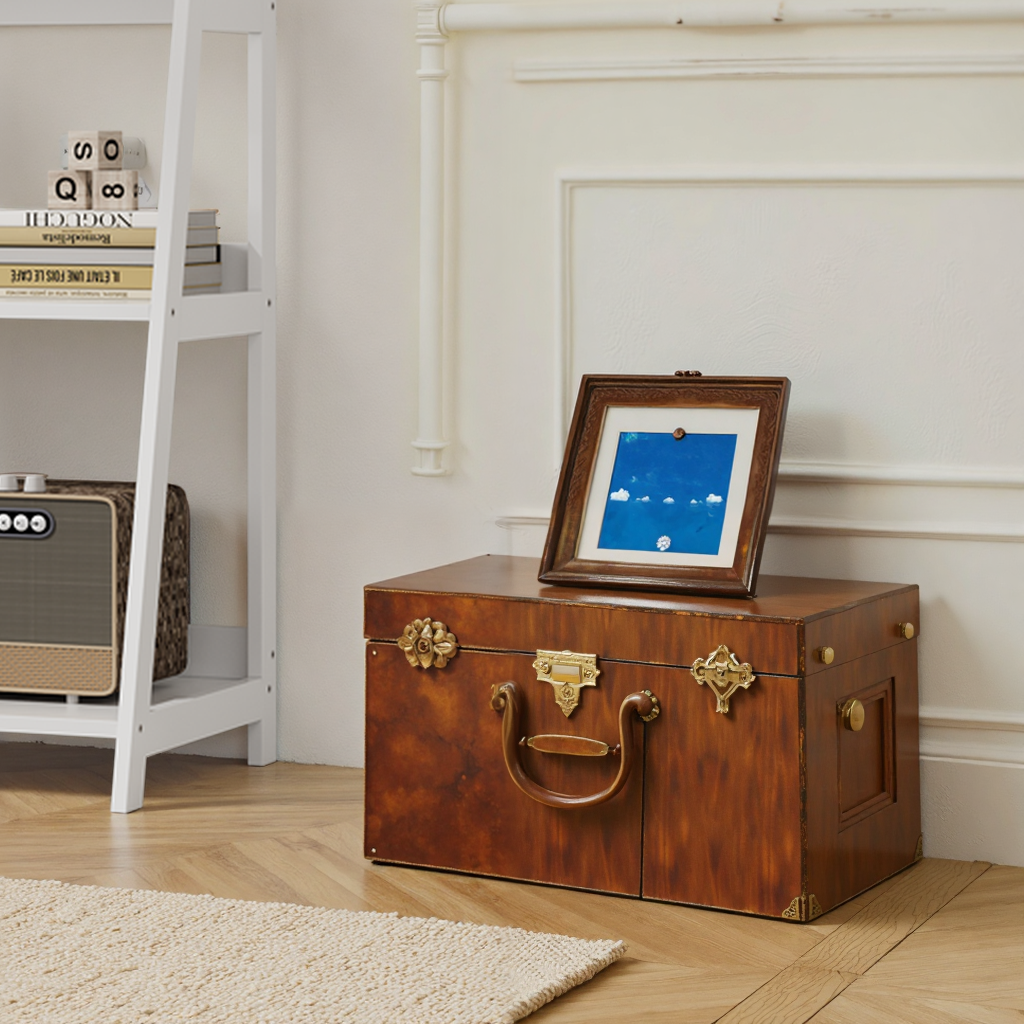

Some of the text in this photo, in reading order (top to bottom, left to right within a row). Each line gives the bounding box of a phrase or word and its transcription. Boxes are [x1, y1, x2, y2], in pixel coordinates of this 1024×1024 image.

[73, 141, 93, 160] S
[55, 177, 77, 201] Q
[101, 183, 125, 199] 8
[26, 212, 133, 228] NOGUCHI
[34, 269, 45, 284] LE
